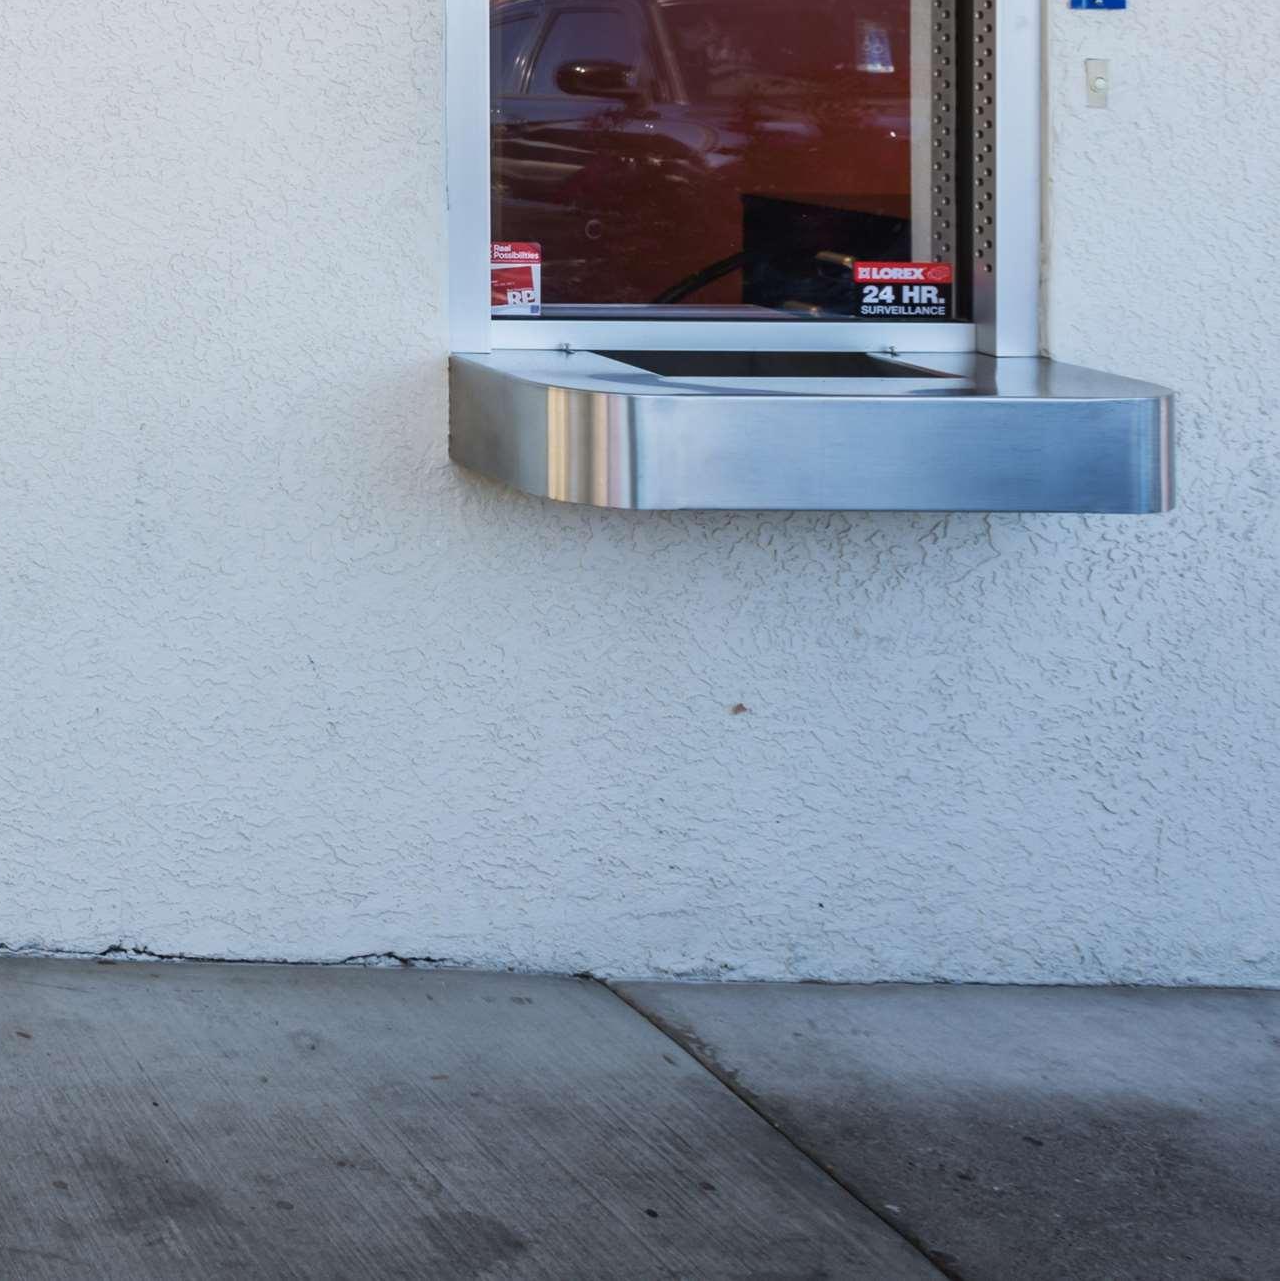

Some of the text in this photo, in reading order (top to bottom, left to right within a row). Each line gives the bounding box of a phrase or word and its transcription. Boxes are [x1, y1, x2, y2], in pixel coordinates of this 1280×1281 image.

[493, 244, 512, 253] Real
[493, 251, 540, 261] Possibilities
[871, 266, 926, 280] LOREX
[862, 285, 945, 304] 24 HR.
[861, 305, 945, 316] SURVEILLANCE
